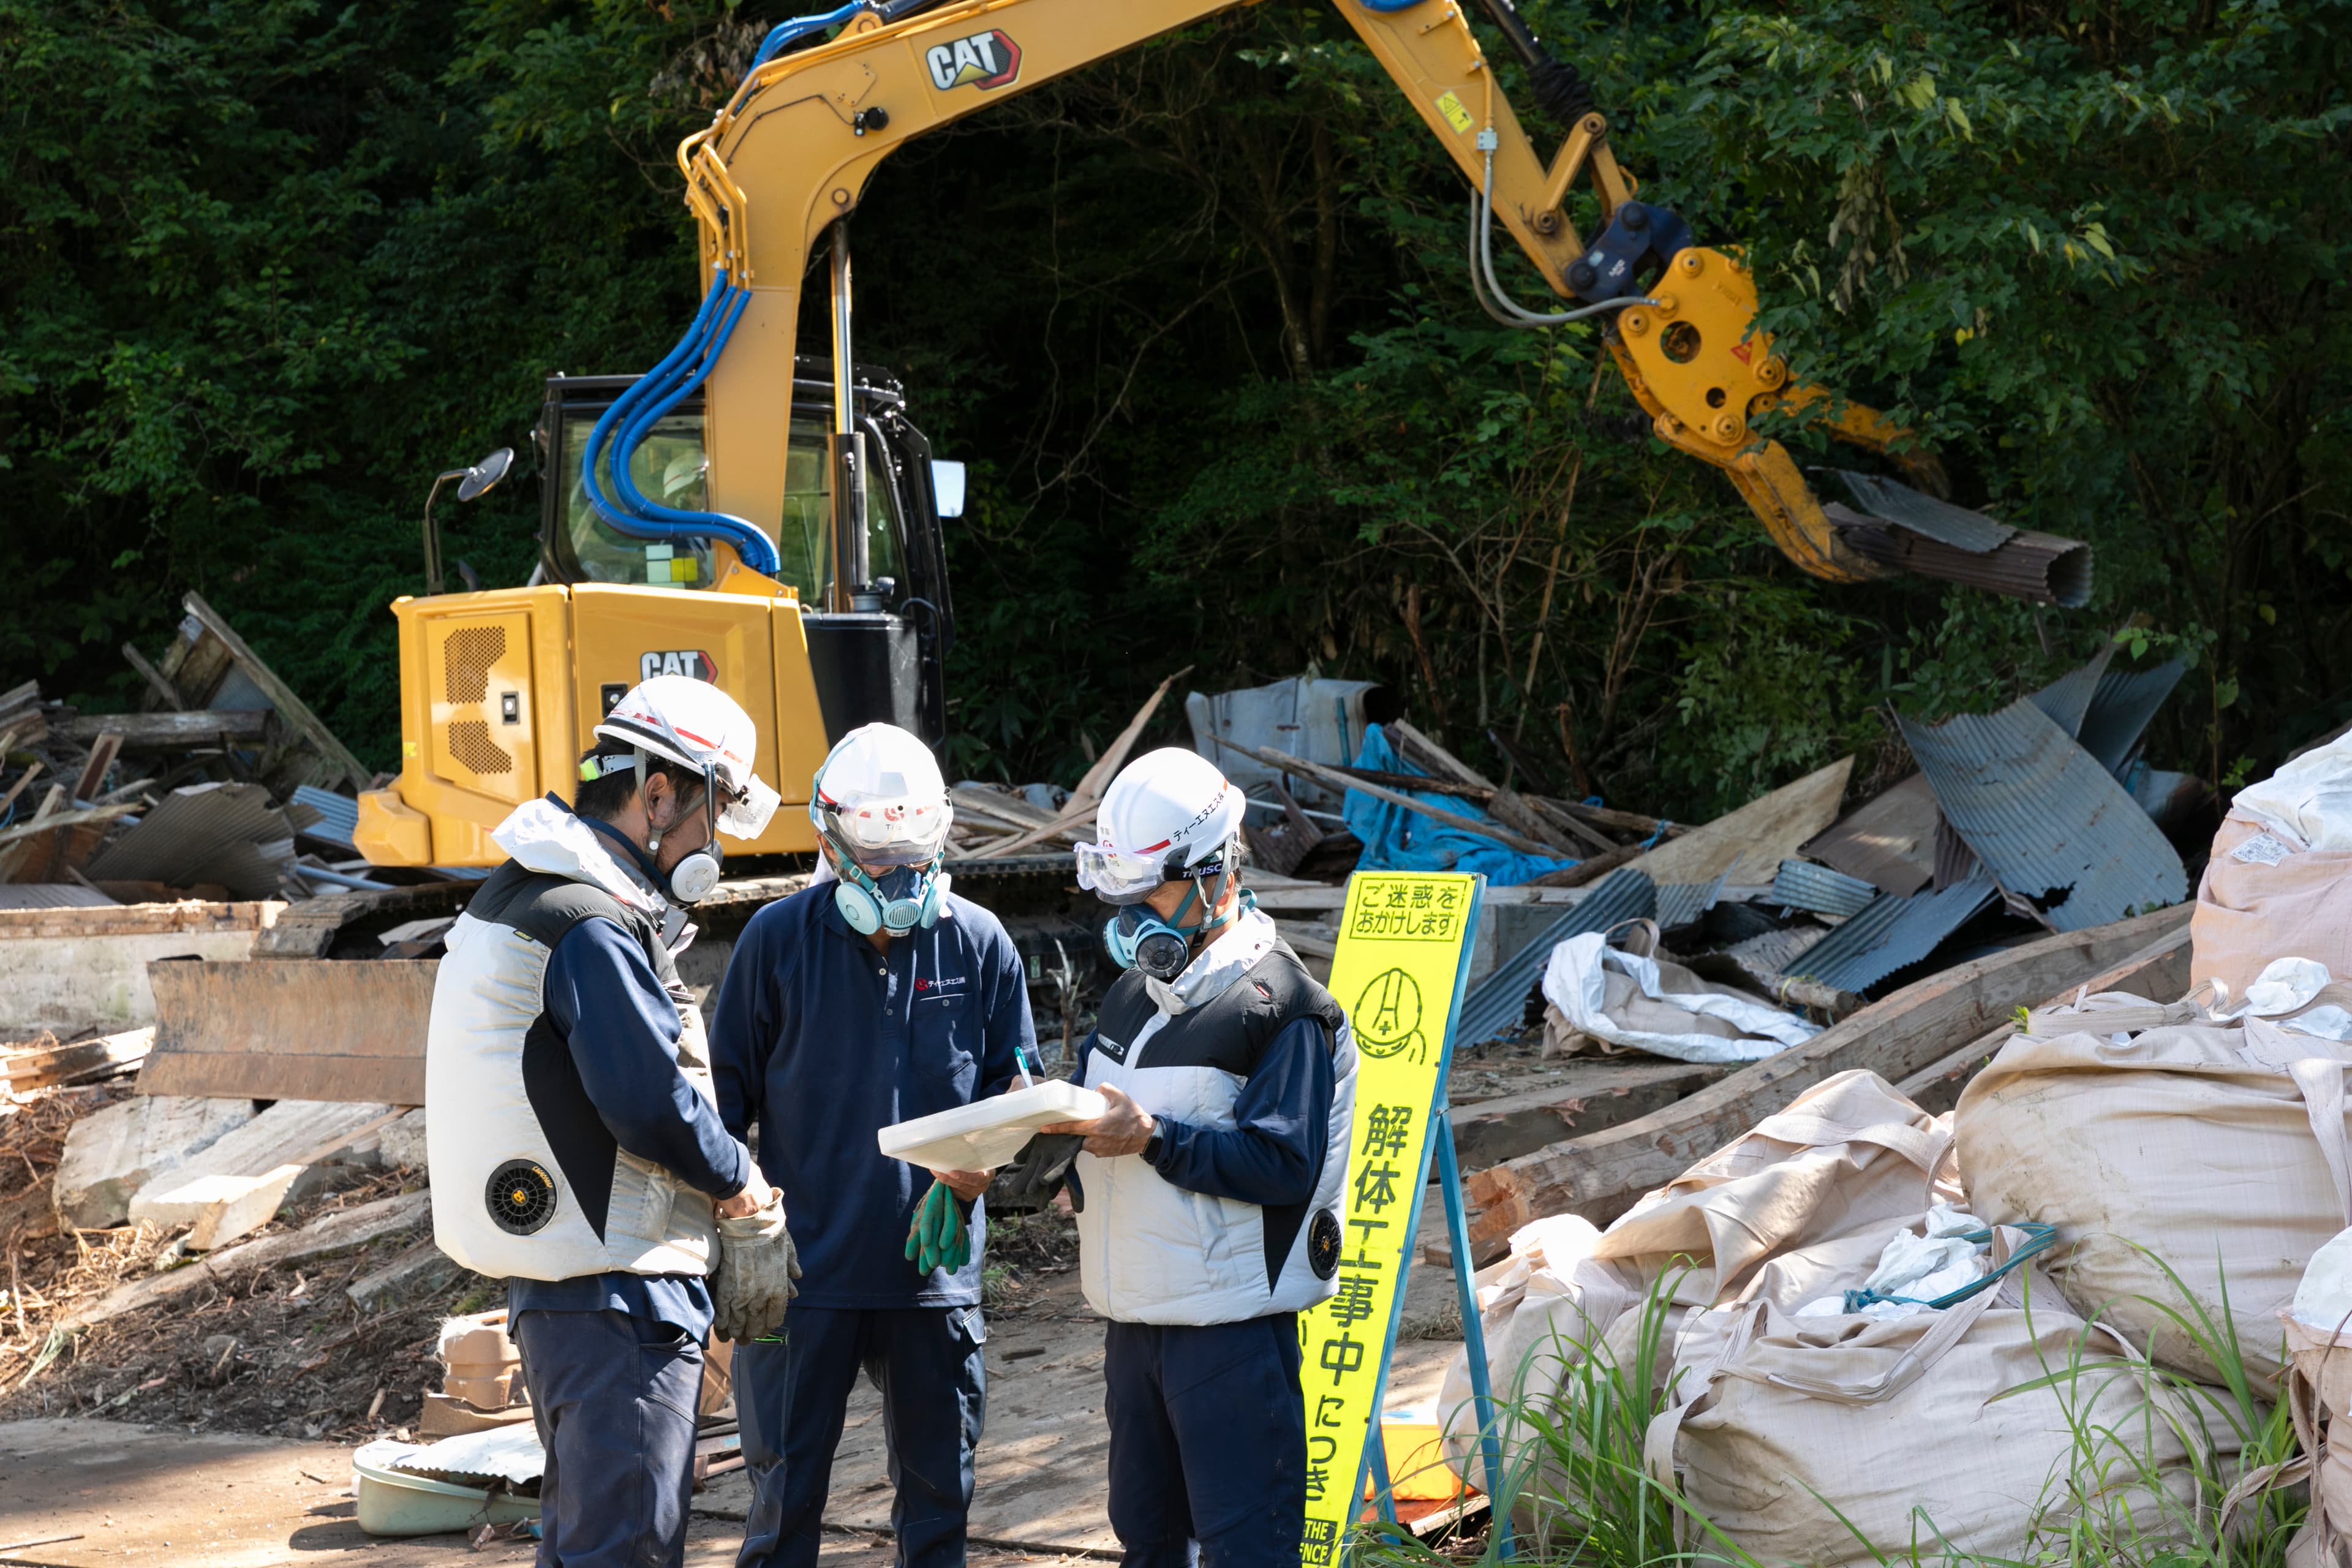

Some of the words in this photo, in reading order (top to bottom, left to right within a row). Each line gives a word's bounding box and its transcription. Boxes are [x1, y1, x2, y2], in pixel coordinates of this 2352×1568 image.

[927, 31, 998, 89] CAT
[641, 651, 699, 682] CAT
[1361, 883, 1459, 910] ご迷惑を
[1355, 910, 1455, 937] おかけします
[1306, 1103, 1412, 1501] 解体工事中につき
[1305, 1520, 1329, 1540] THE
